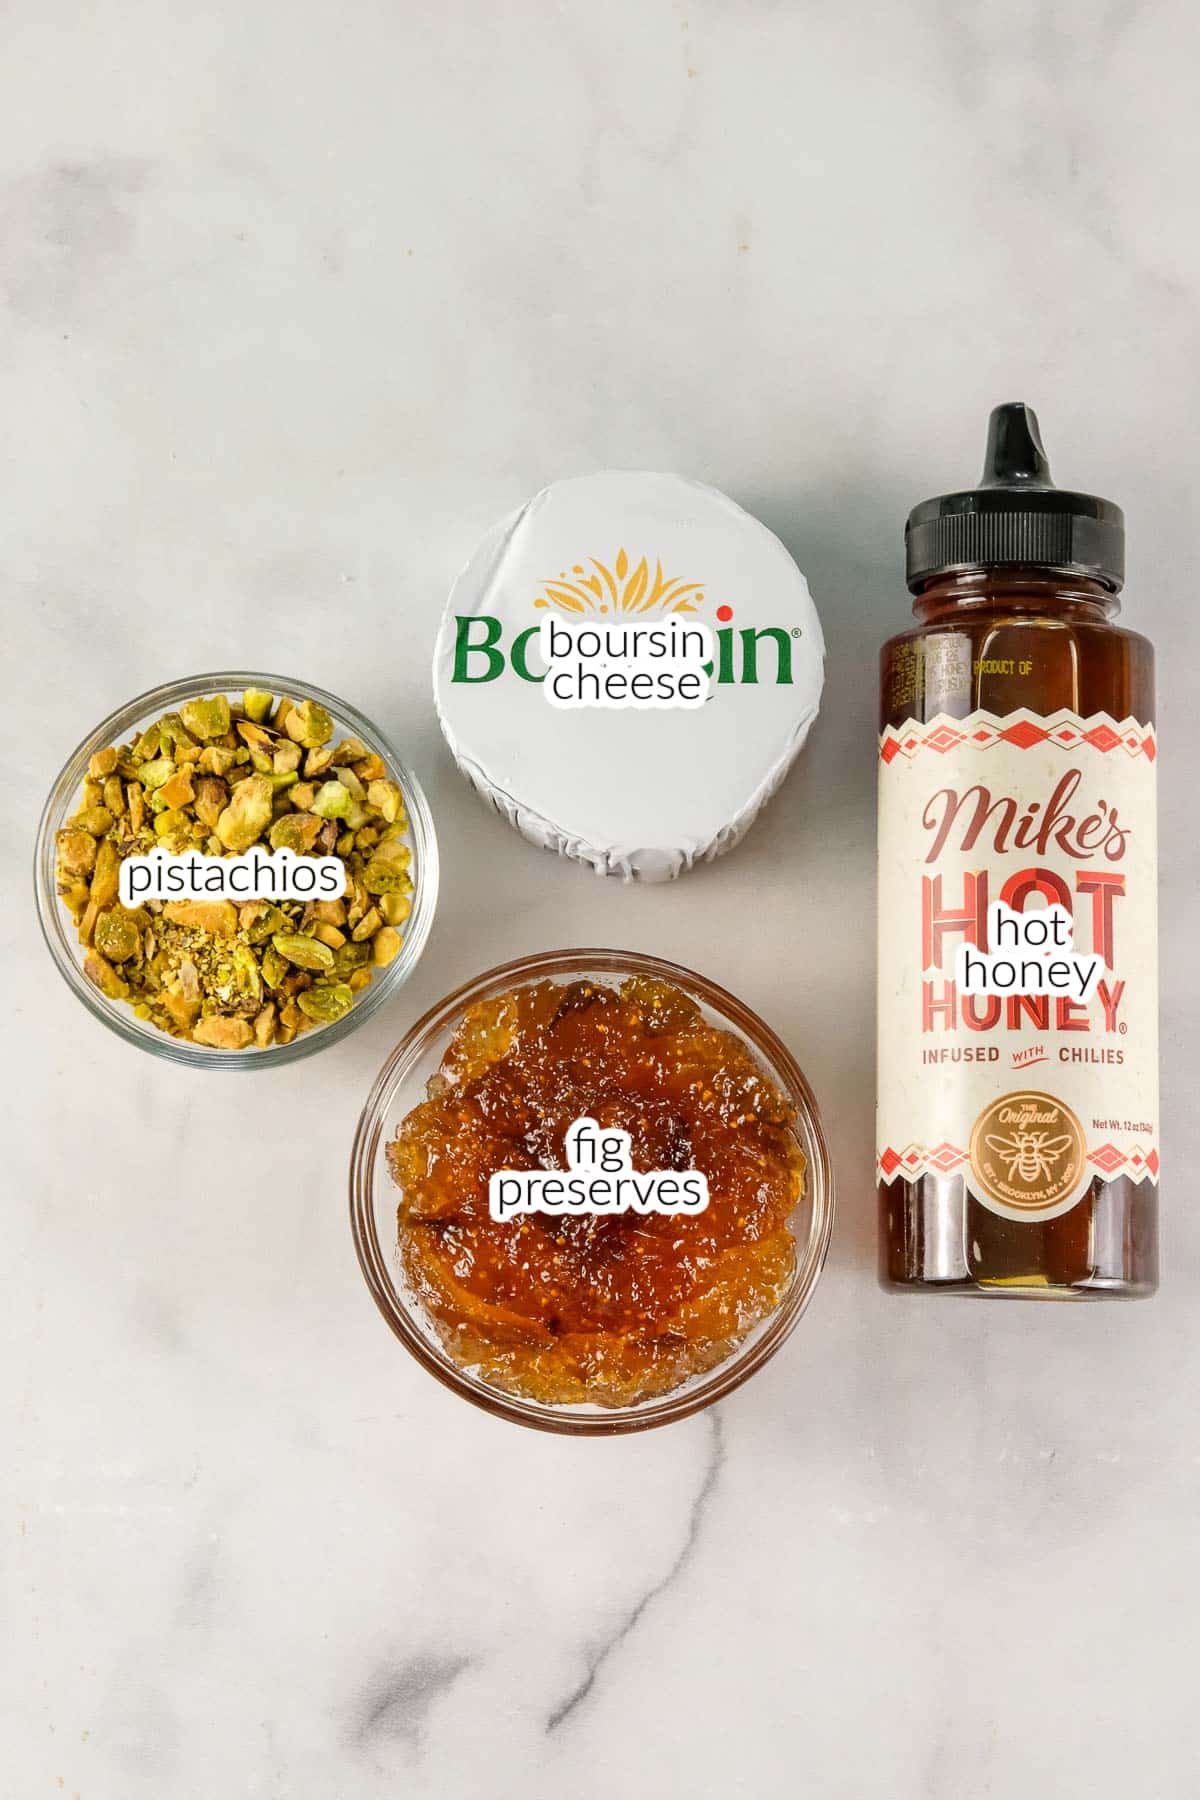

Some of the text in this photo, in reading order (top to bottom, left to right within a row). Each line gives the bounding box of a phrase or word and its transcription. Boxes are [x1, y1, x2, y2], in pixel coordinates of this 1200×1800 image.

[451, 605, 794, 684] Boin
[974, 660, 1014, 674] PRODUCT
[1019, 661, 1032, 675] OF
[922, 768, 1131, 864] Mike's
[922, 1045, 1125, 1065] INFUSED WITH CHILIES
[999, 1107, 1059, 1129] Original
[1092, 1119, 1107, 1129] Net
[1109, 1119, 1122, 1130] Wt.
[1124, 1120, 1131, 1131] 12
